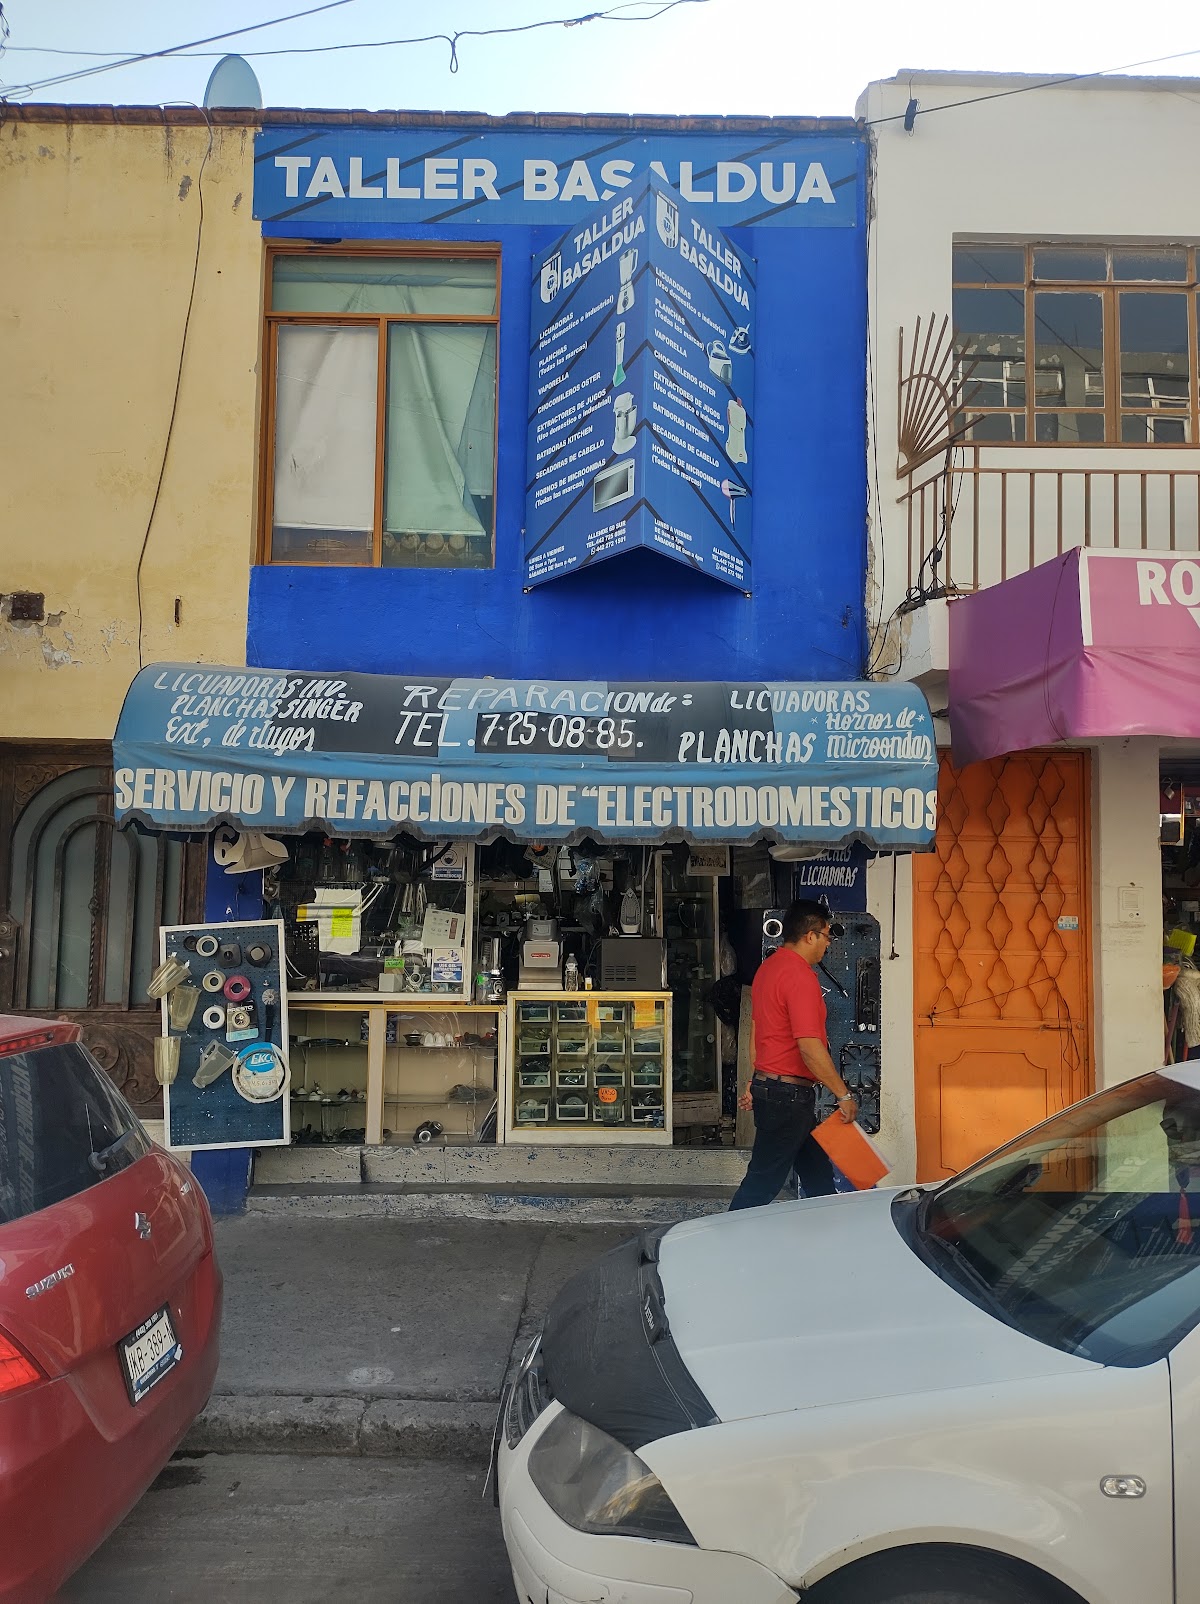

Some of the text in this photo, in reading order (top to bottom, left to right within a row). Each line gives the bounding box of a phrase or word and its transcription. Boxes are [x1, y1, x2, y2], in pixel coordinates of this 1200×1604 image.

[274, 156, 500, 201] TALLER
[573, 196, 634, 255] TALLER
[562, 215, 646, 290] BASALDUA
[690, 218, 742, 280] TALLER
[655, 266, 692, 300] LICUADORAS
[680, 236, 750, 311] BASALDUA
[539, 311, 574, 340] LICUADORAS
[654, 297, 686, 326] PLANCHAS
[674, 322, 683, 334] las
[538, 344, 568, 368] PLANCHAS
[654, 328, 688, 358] VAPORELLA
[556, 357, 565, 367] las
[653, 349, 717, 398] CHOCOMILEROS OSTER
[537, 371, 570, 396] VAPORELLA
[537, 371, 601, 414] CHOCOMILEROS OSTER
[653, 369, 721, 420] EXTRACTORES DE JUGOS
[536, 388, 607, 433] EXTRACTORES DE JUGOS
[652, 401, 710, 443] BATIDORAS KITCHEN
[535, 438, 605, 480] SECADORAS DE CABELLO
[536, 425, 593, 461] BATIDORAS KITCHEN
[652, 422, 720, 468] SECADORAS DE CABELLO
[535, 458, 606, 498] HORNOS DE MICROONDAS
[651, 443, 721, 489] HORNOS DE MICROONDAS
[671, 464, 680, 476] las
[153, 671, 304, 699] LICUADORAS
[402, 684, 654, 714] REPARACION
[730, 690, 871, 713] LICUADORAS
[170, 694, 365, 723] PLANCHAS SINGER
[895, 706, 918, 729] de
[221, 718, 248, 748] de
[394, 710, 476, 748] TEL.
[677, 728, 818, 764] PLANCHAS
[115, 768, 266, 816] SERVICIO
[271, 776, 297, 818] Y
[535, 784, 577, 826] DE
[800, 865, 859, 888] LICUADORAS
[24, 1262, 76, 1300] SUZUKI
